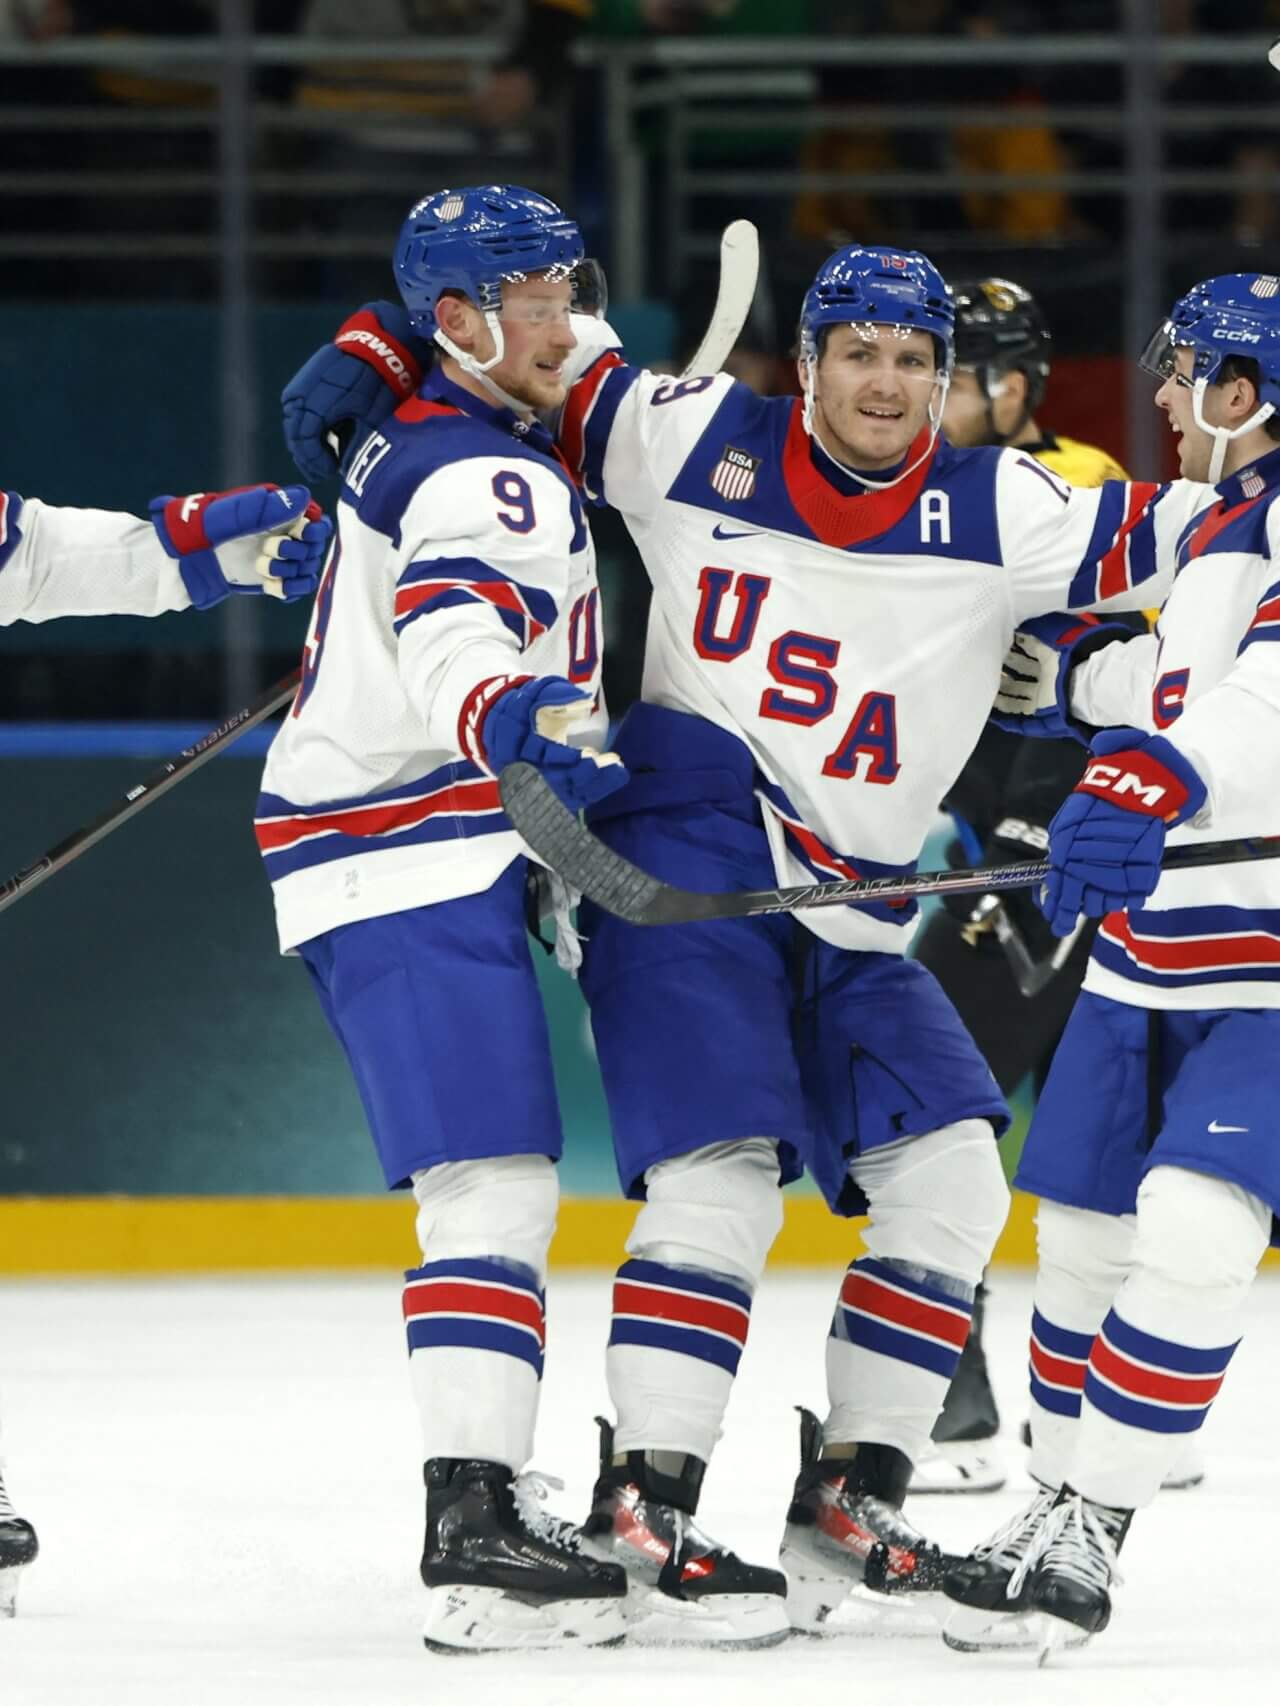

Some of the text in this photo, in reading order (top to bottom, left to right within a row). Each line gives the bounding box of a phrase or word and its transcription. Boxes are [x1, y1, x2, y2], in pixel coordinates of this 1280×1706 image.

[1212, 328, 1260, 345] CCM
[727, 450, 753, 470] USA
[491, 469, 537, 536] 9
[919, 488, 953, 544] A
[693, 566, 902, 785] USA
[1082, 763, 1167, 807] CM
